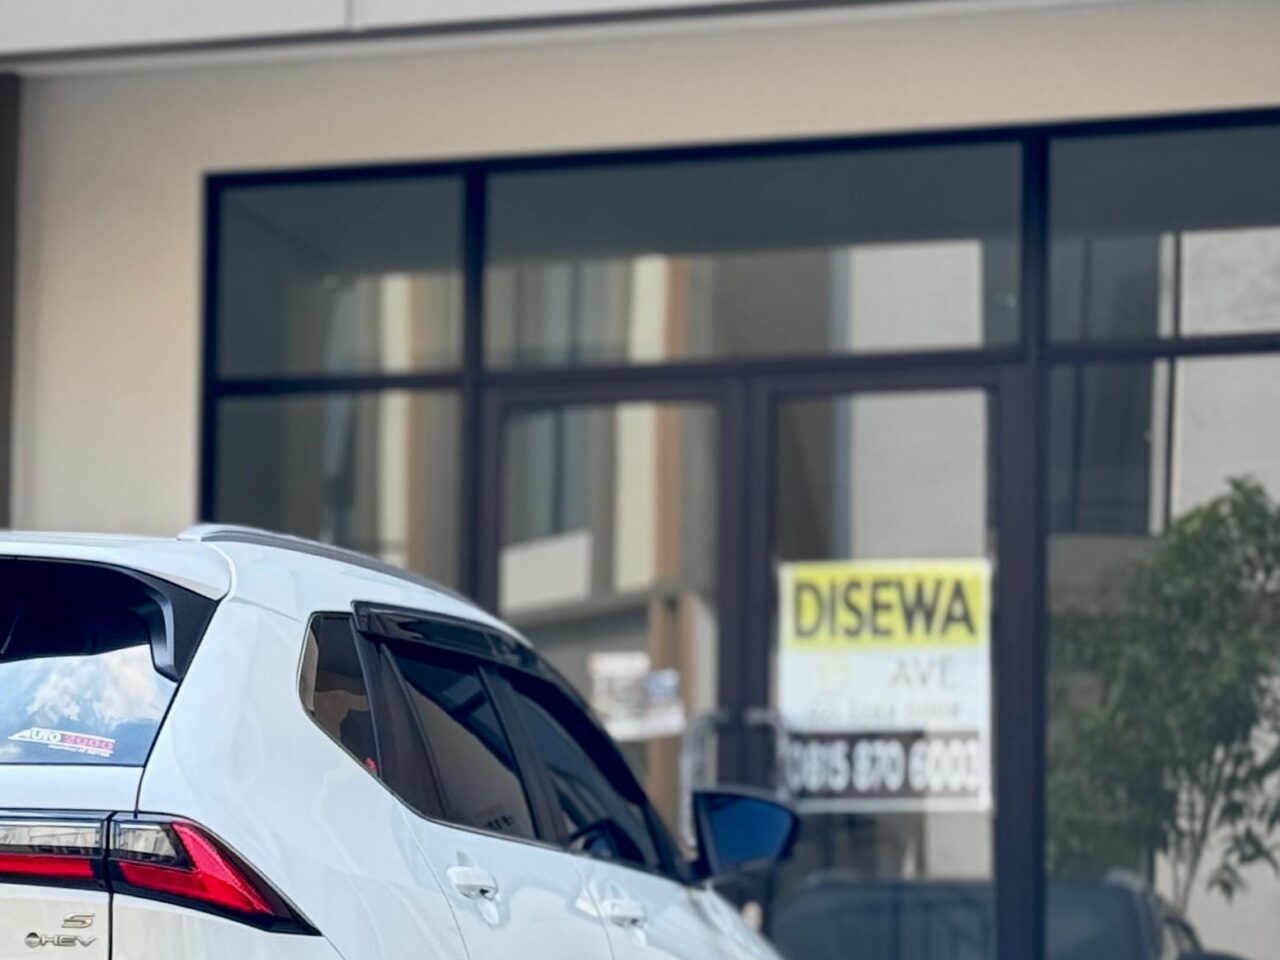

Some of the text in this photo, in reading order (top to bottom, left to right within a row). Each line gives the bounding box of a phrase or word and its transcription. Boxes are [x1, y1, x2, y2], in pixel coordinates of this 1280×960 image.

[793, 579, 977, 638] DISEWA
[63, 734, 114, 750] 2000
[61, 913, 95, 929] S
